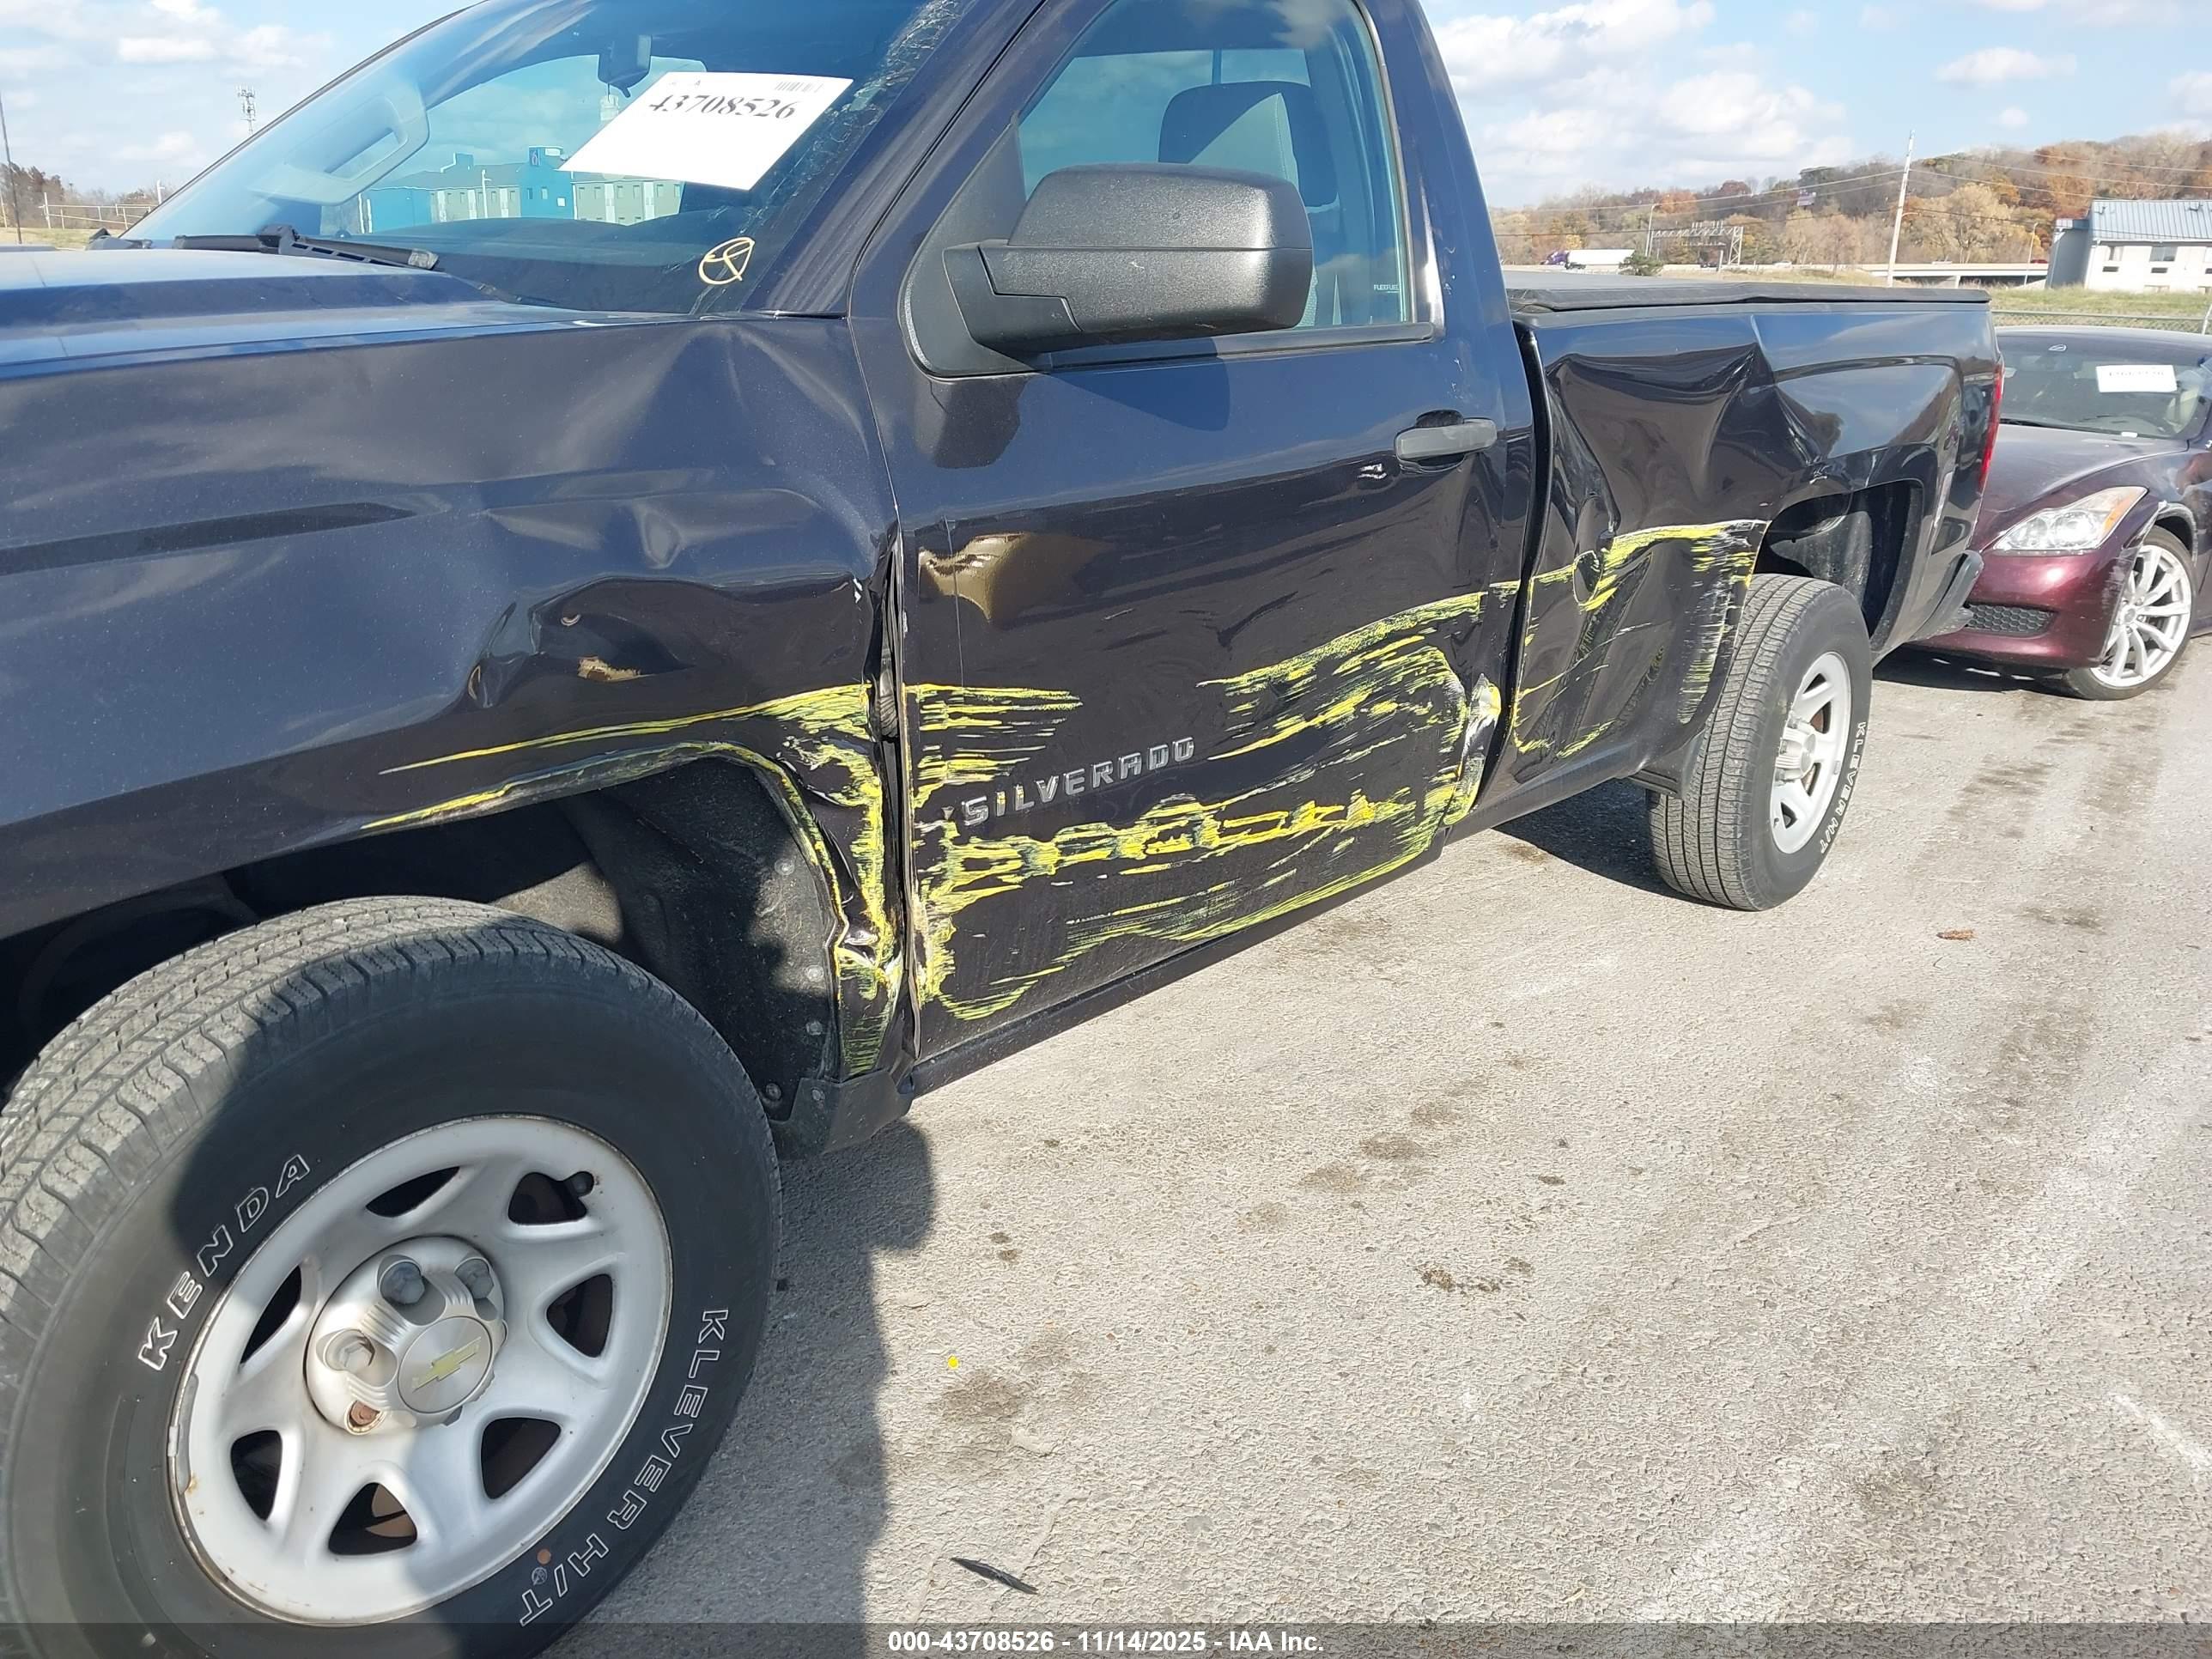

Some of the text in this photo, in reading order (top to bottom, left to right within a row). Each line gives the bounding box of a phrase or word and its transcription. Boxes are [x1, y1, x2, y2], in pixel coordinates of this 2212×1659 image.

[648, 94, 803, 119] 43708526
[961, 736, 1195, 826] SILVERADO
[1820, 721, 1866, 854] KLEVER H/T
[137, 1153, 311, 1371] KENDA
[519, 1308, 729, 1627] KLEVER H/T
